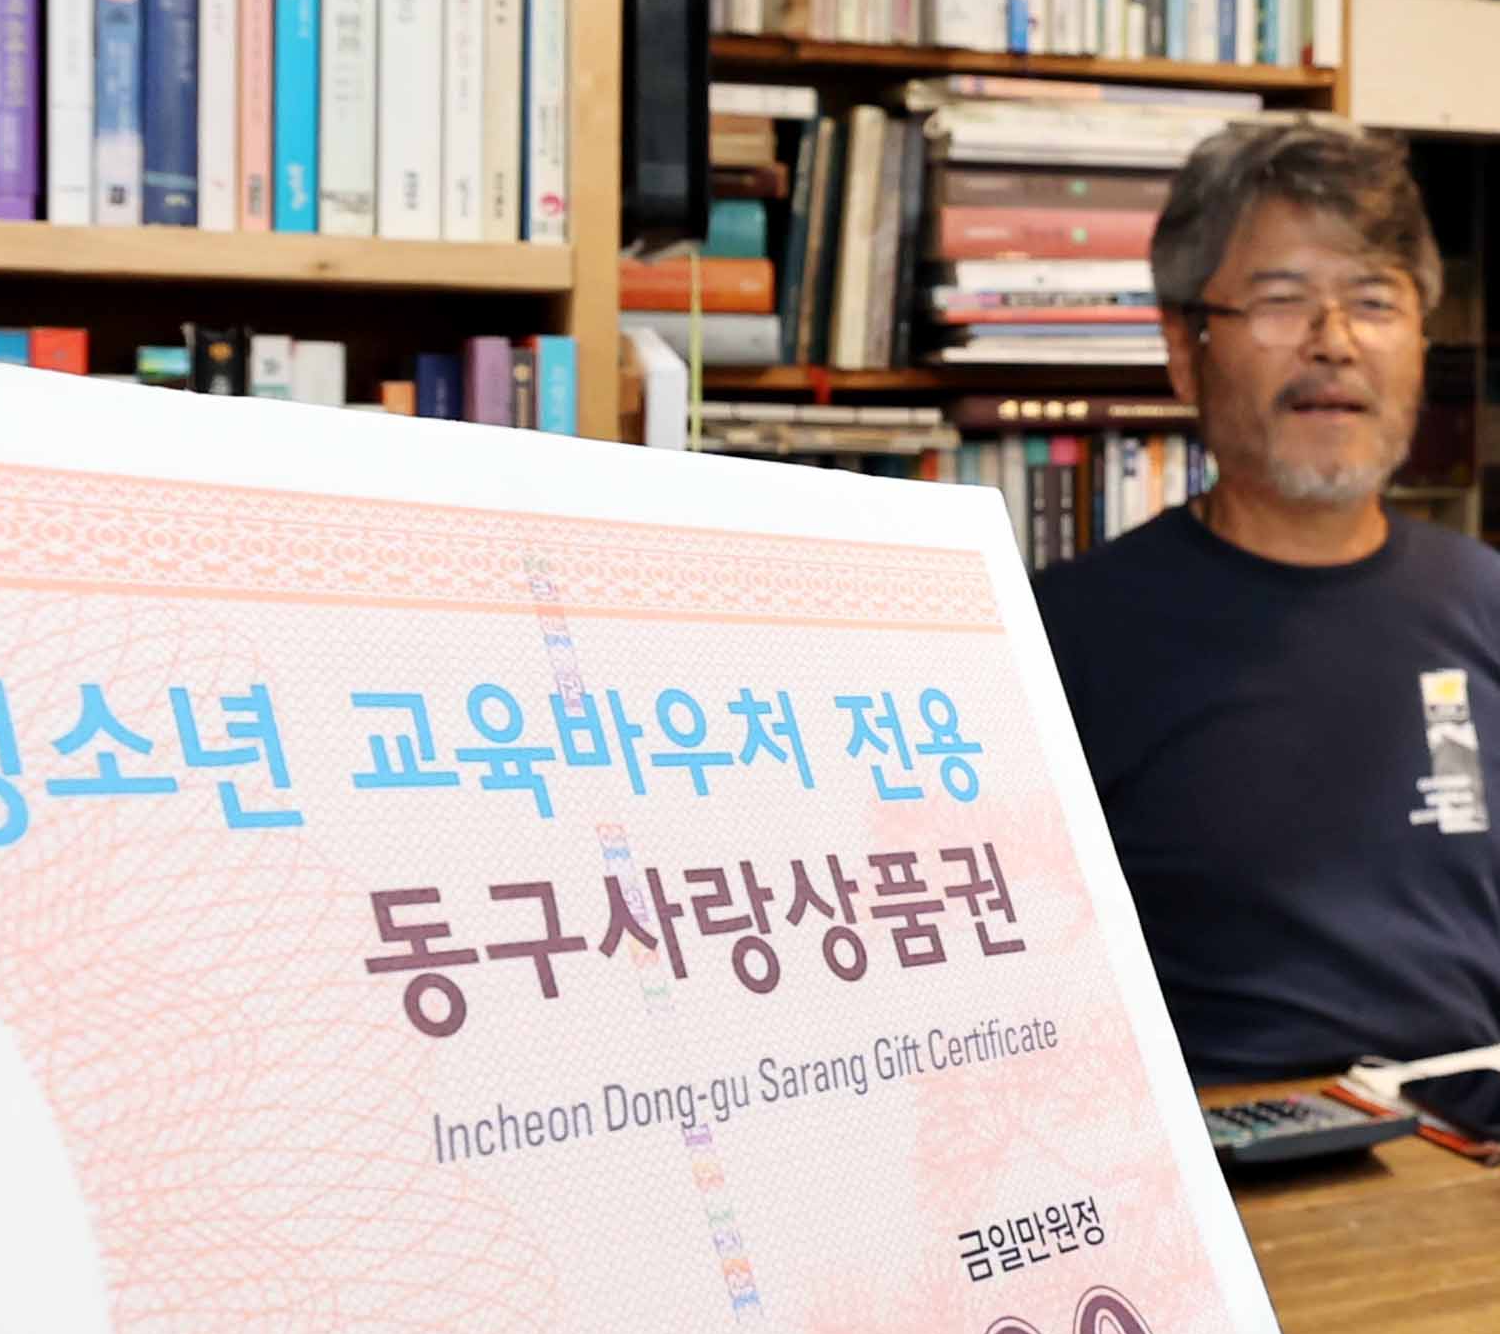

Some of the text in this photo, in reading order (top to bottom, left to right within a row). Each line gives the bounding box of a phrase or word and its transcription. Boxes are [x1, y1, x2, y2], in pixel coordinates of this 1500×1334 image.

[352, 683, 815, 819] 교육바우처
[836, 688, 982, 802] 전용
[365, 842, 1026, 1038] 동구사랑상품권
[434, 1018, 1057, 1164] Incheon Dong-gu Sarang Gift Certificate
[958, 1196, 1105, 1282] 금일만원정
